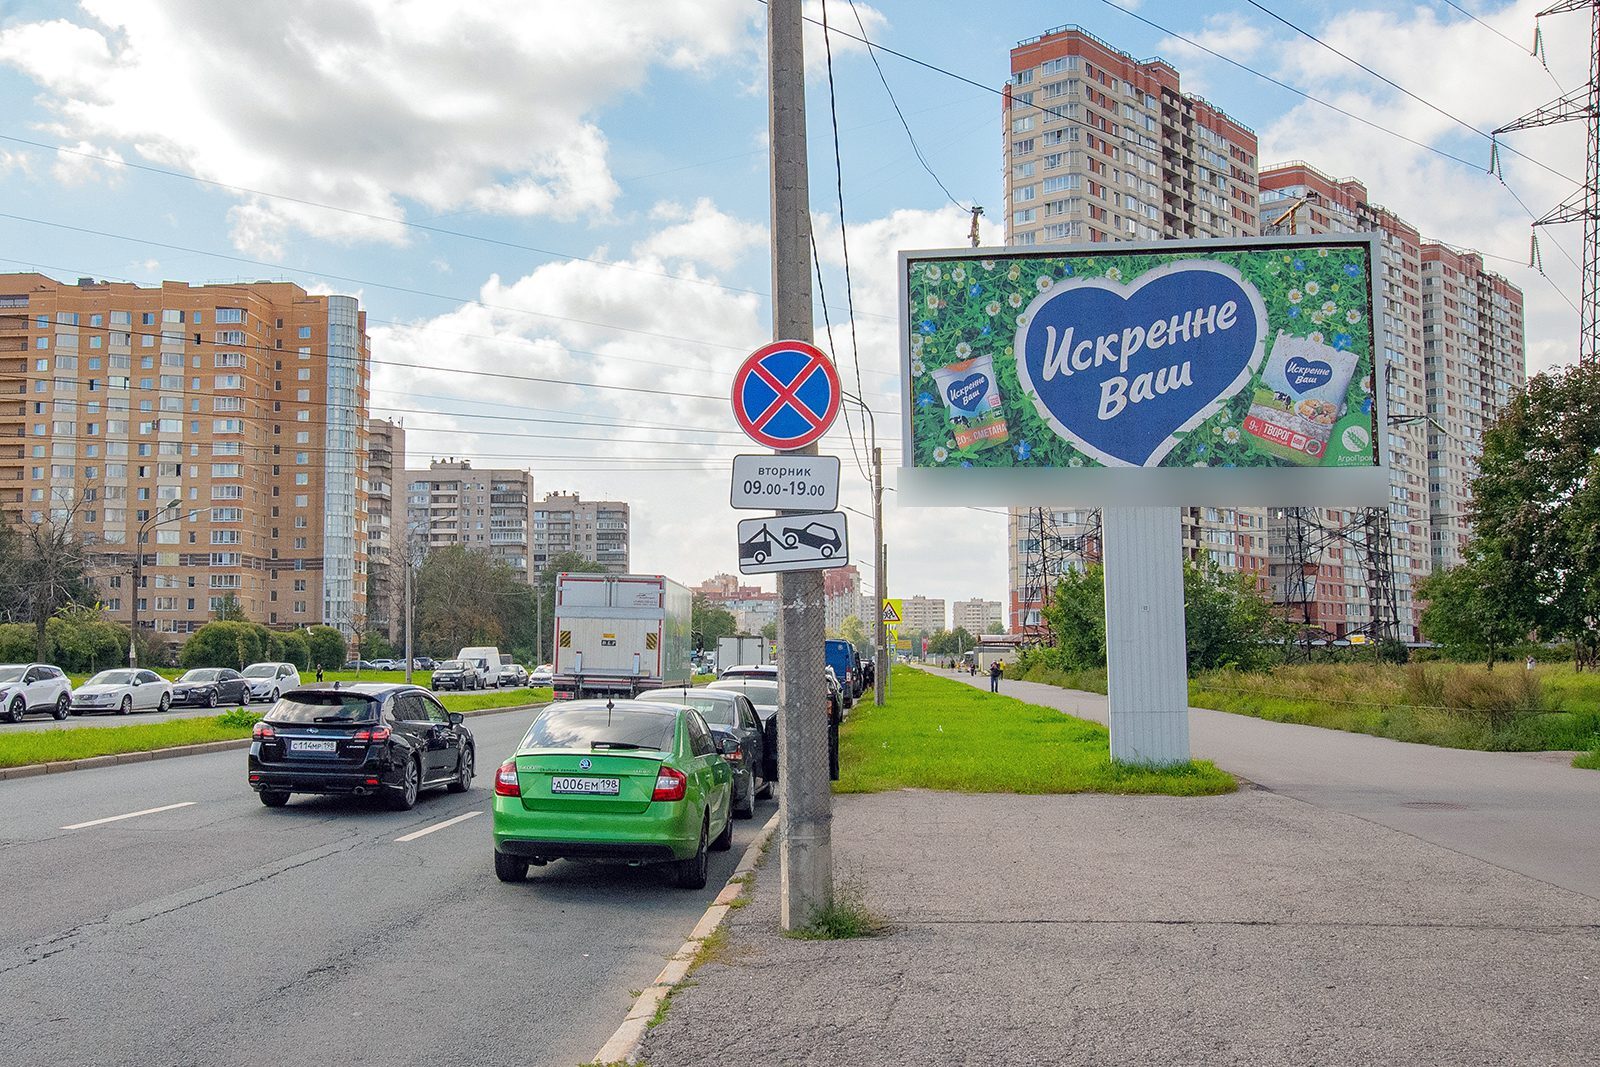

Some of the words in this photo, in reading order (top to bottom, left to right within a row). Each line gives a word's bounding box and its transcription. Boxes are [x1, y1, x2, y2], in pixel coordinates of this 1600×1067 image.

[1042, 299, 1237, 381] Искренне
[1287, 361, 1330, 376] Искренне
[950, 376, 985, 401] Искренне
[1295, 376, 1317, 384] Ваш
[962, 390, 980, 406] Ваш
[1098, 359, 1193, 421] Ваш
[973, 423, 1007, 440] СМЕТАНА
[1263, 423, 1292, 441] ТВОРОГ
[758, 466, 811, 479] вторник
[743, 480, 825, 497] 09.00-19.00
[601, 780, 617, 789] 198
